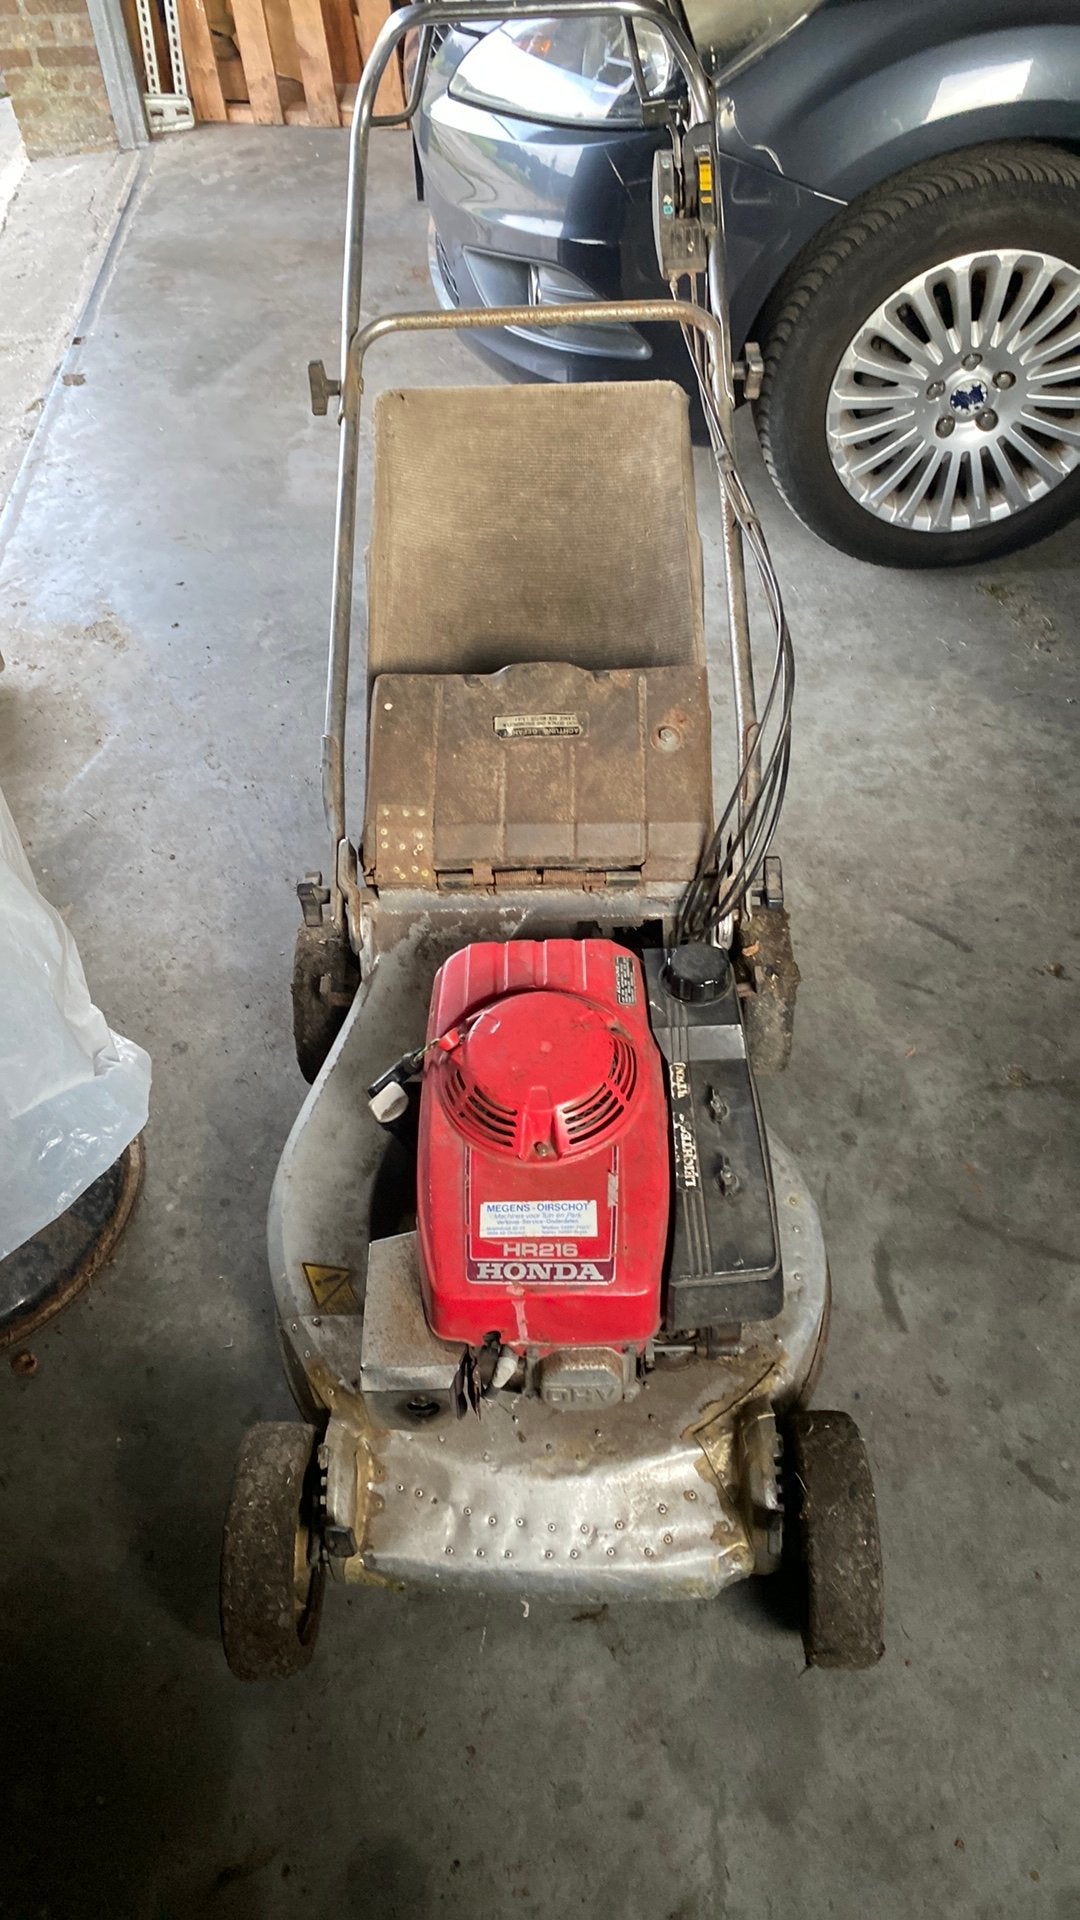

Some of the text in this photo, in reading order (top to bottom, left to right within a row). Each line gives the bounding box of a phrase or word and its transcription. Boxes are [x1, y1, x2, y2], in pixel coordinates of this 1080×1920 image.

[486, 1204, 530, 1213] MEGENS
[537, 1202, 588, 1212] OIRSCHOT
[503, 1243, 578, 1257] HR216
[477, 1263, 604, 1280] HONDA
[546, 1387, 616, 1402] OHV
